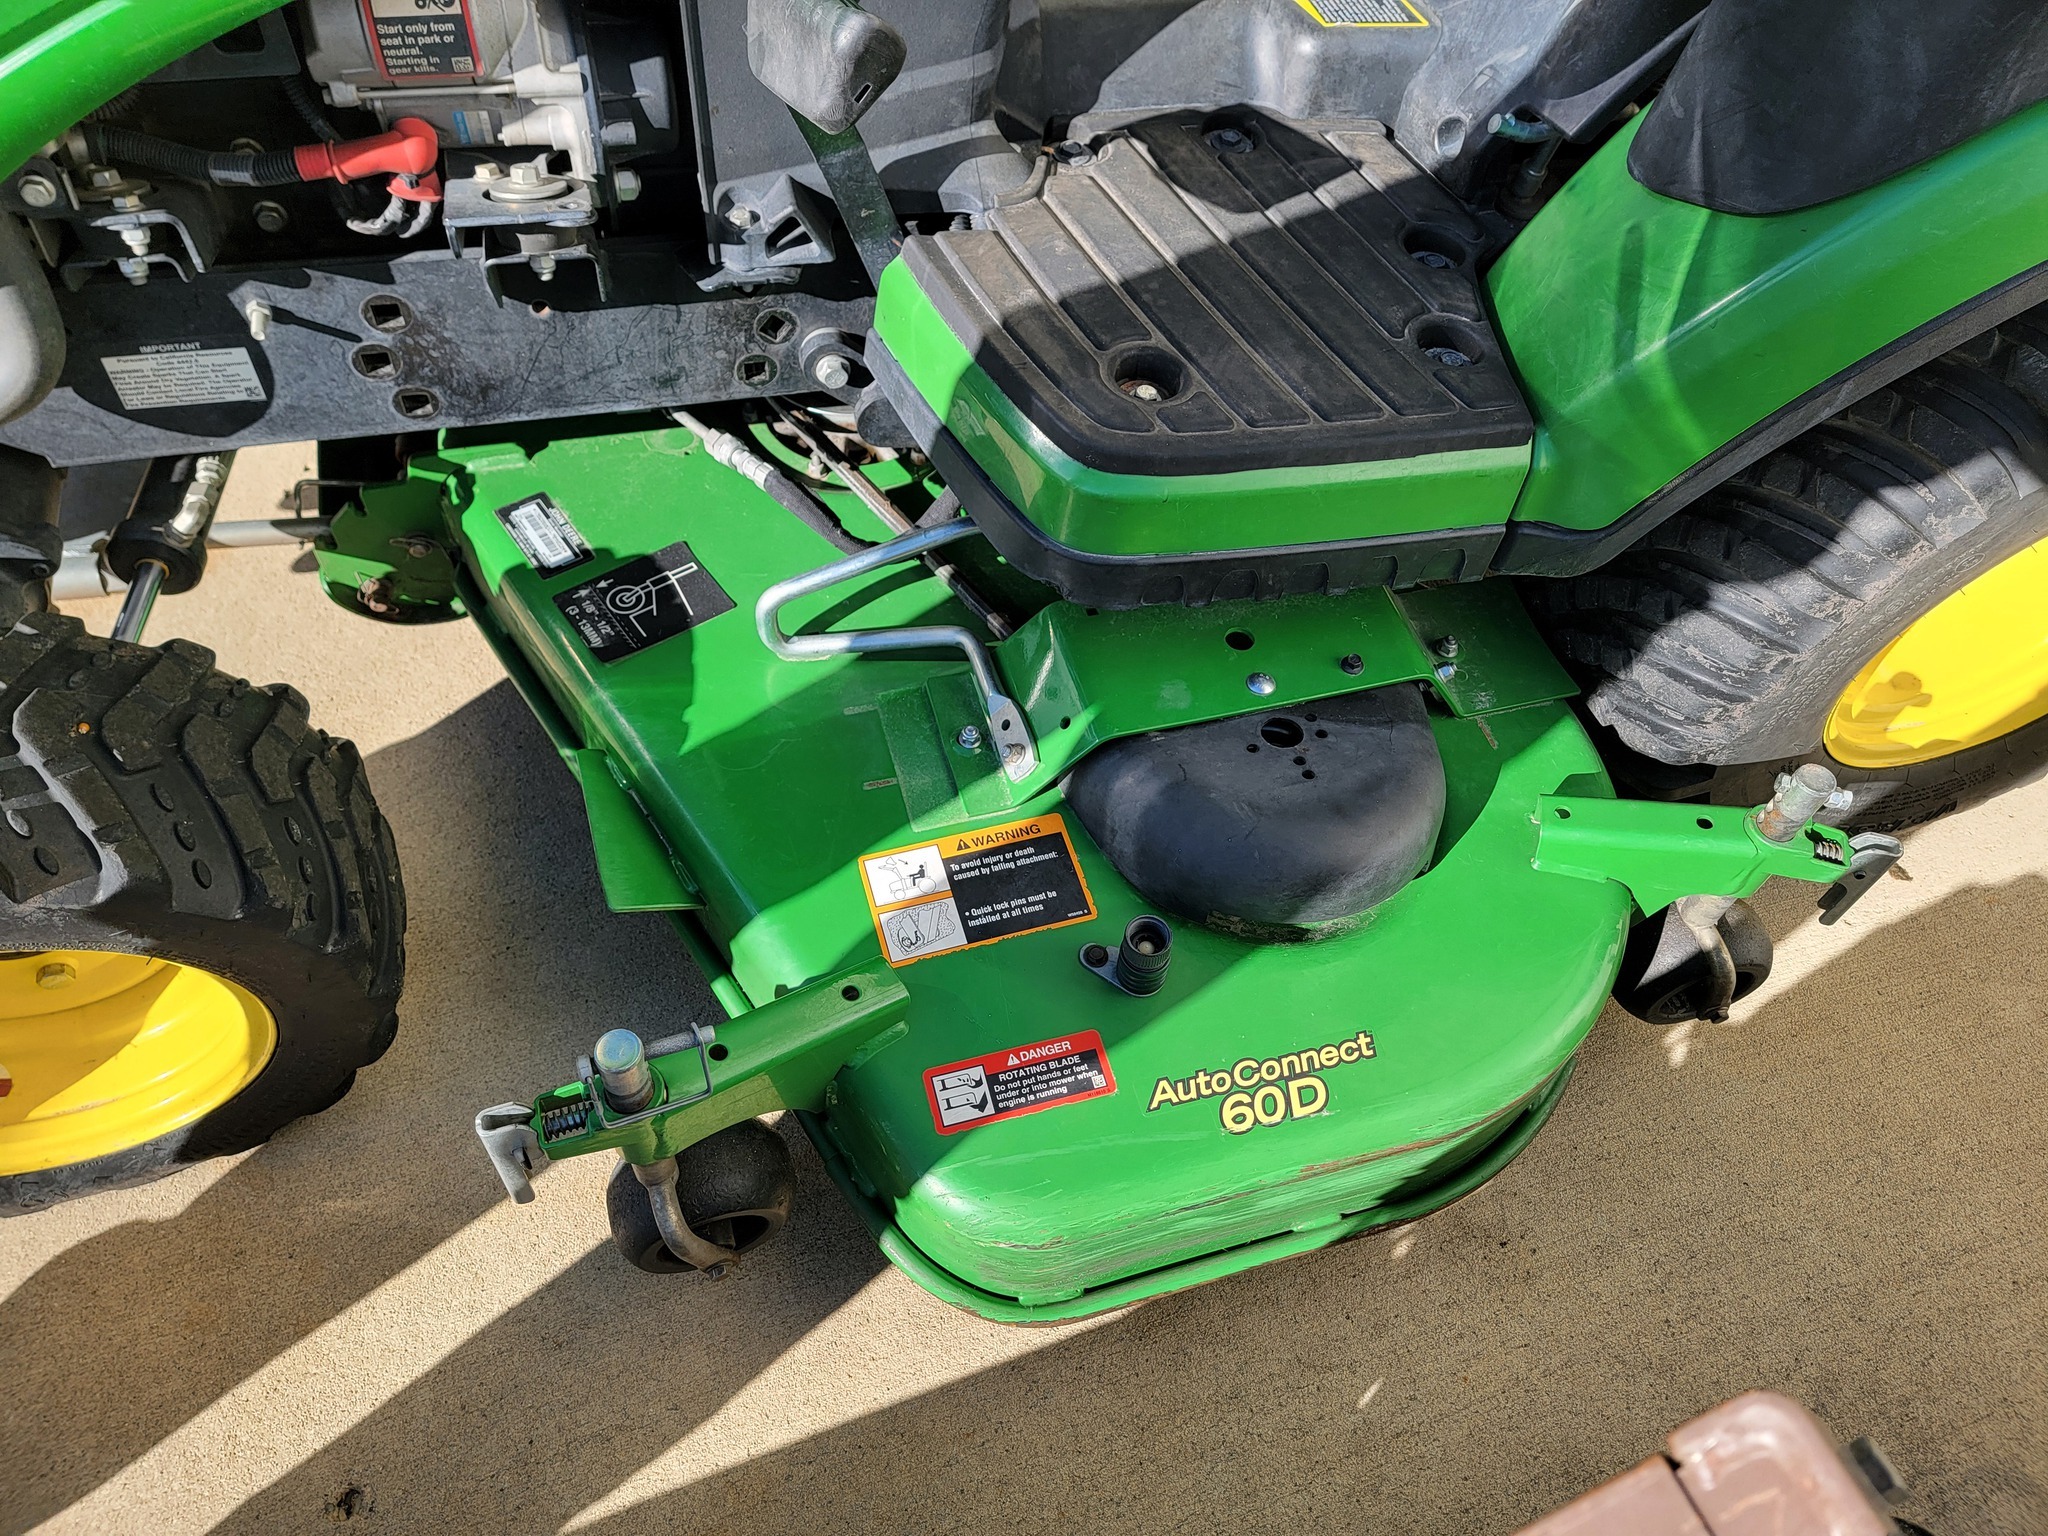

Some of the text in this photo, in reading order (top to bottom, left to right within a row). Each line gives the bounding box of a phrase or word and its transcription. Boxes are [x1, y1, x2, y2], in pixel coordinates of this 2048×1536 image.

[377, 22, 455, 34] Start only from
[381, 35, 454, 46] seat in park or
[383, 46, 423, 57] neutral.
[386, 56, 440, 67] Starting in
[389, 64, 438, 75] gear kills.
[139, 342, 202, 354] IMPORTANT
[549, 507, 584, 547] JOHN DEERE
[565, 605, 580, 616] (3
[578, 619, 604, 648] 13MM)
[971, 824, 1041, 848] WARNING
[950, 864, 959, 872] To
[961, 858, 981, 870] avoid
[982, 854, 1004, 868] injury
[1014, 846, 1035, 857] death
[953, 851, 1058, 881] caused by falling attachment:
[971, 890, 1057, 916] Quick lock pins must be
[968, 904, 1044, 928] installed at all times
[1020, 1041, 1072, 1061] DANGER
[994, 1063, 1088, 1093] Do not put hands or feet
[998, 1055, 1081, 1082] ROTATING BLADE
[1146, 1030, 1377, 1112] AutoConnect
[996, 1089, 1020, 1101] under
[1031, 1083, 1047, 1093] into
[1049, 1076, 1075, 1087] mower
[1077, 1070, 1098, 1082] when
[998, 1096, 1025, 1109] engine
[1036, 1086, 1068, 1100] running
[1220, 1075, 1329, 1135] 60D
